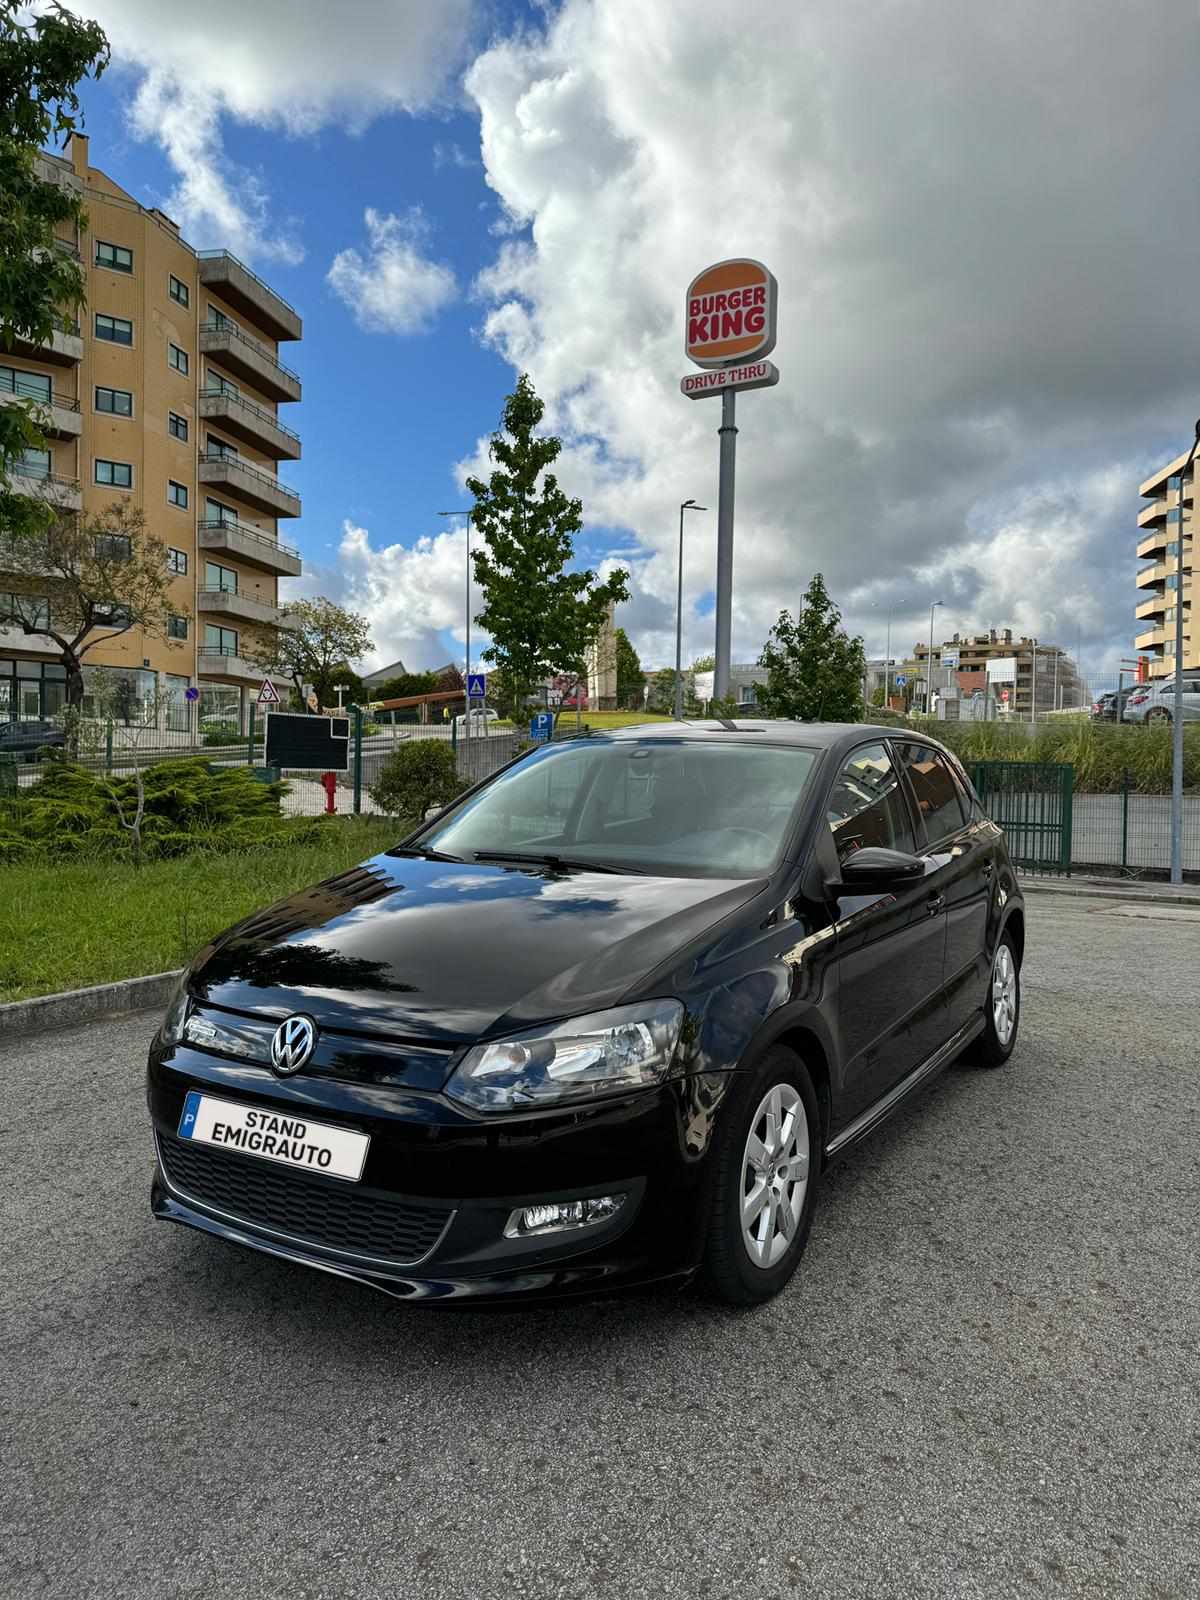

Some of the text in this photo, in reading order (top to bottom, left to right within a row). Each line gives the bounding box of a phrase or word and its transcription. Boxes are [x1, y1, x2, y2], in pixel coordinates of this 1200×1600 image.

[689, 287, 766, 317] BURGER
[688, 306, 765, 344] KING
[685, 364, 767, 391] DRIVE THRU
[538, 715, 548, 728] P
[184, 1113, 194, 1126] P
[245, 1111, 307, 1140] STAND
[211, 1122, 332, 1168] EMIGRAUTO
